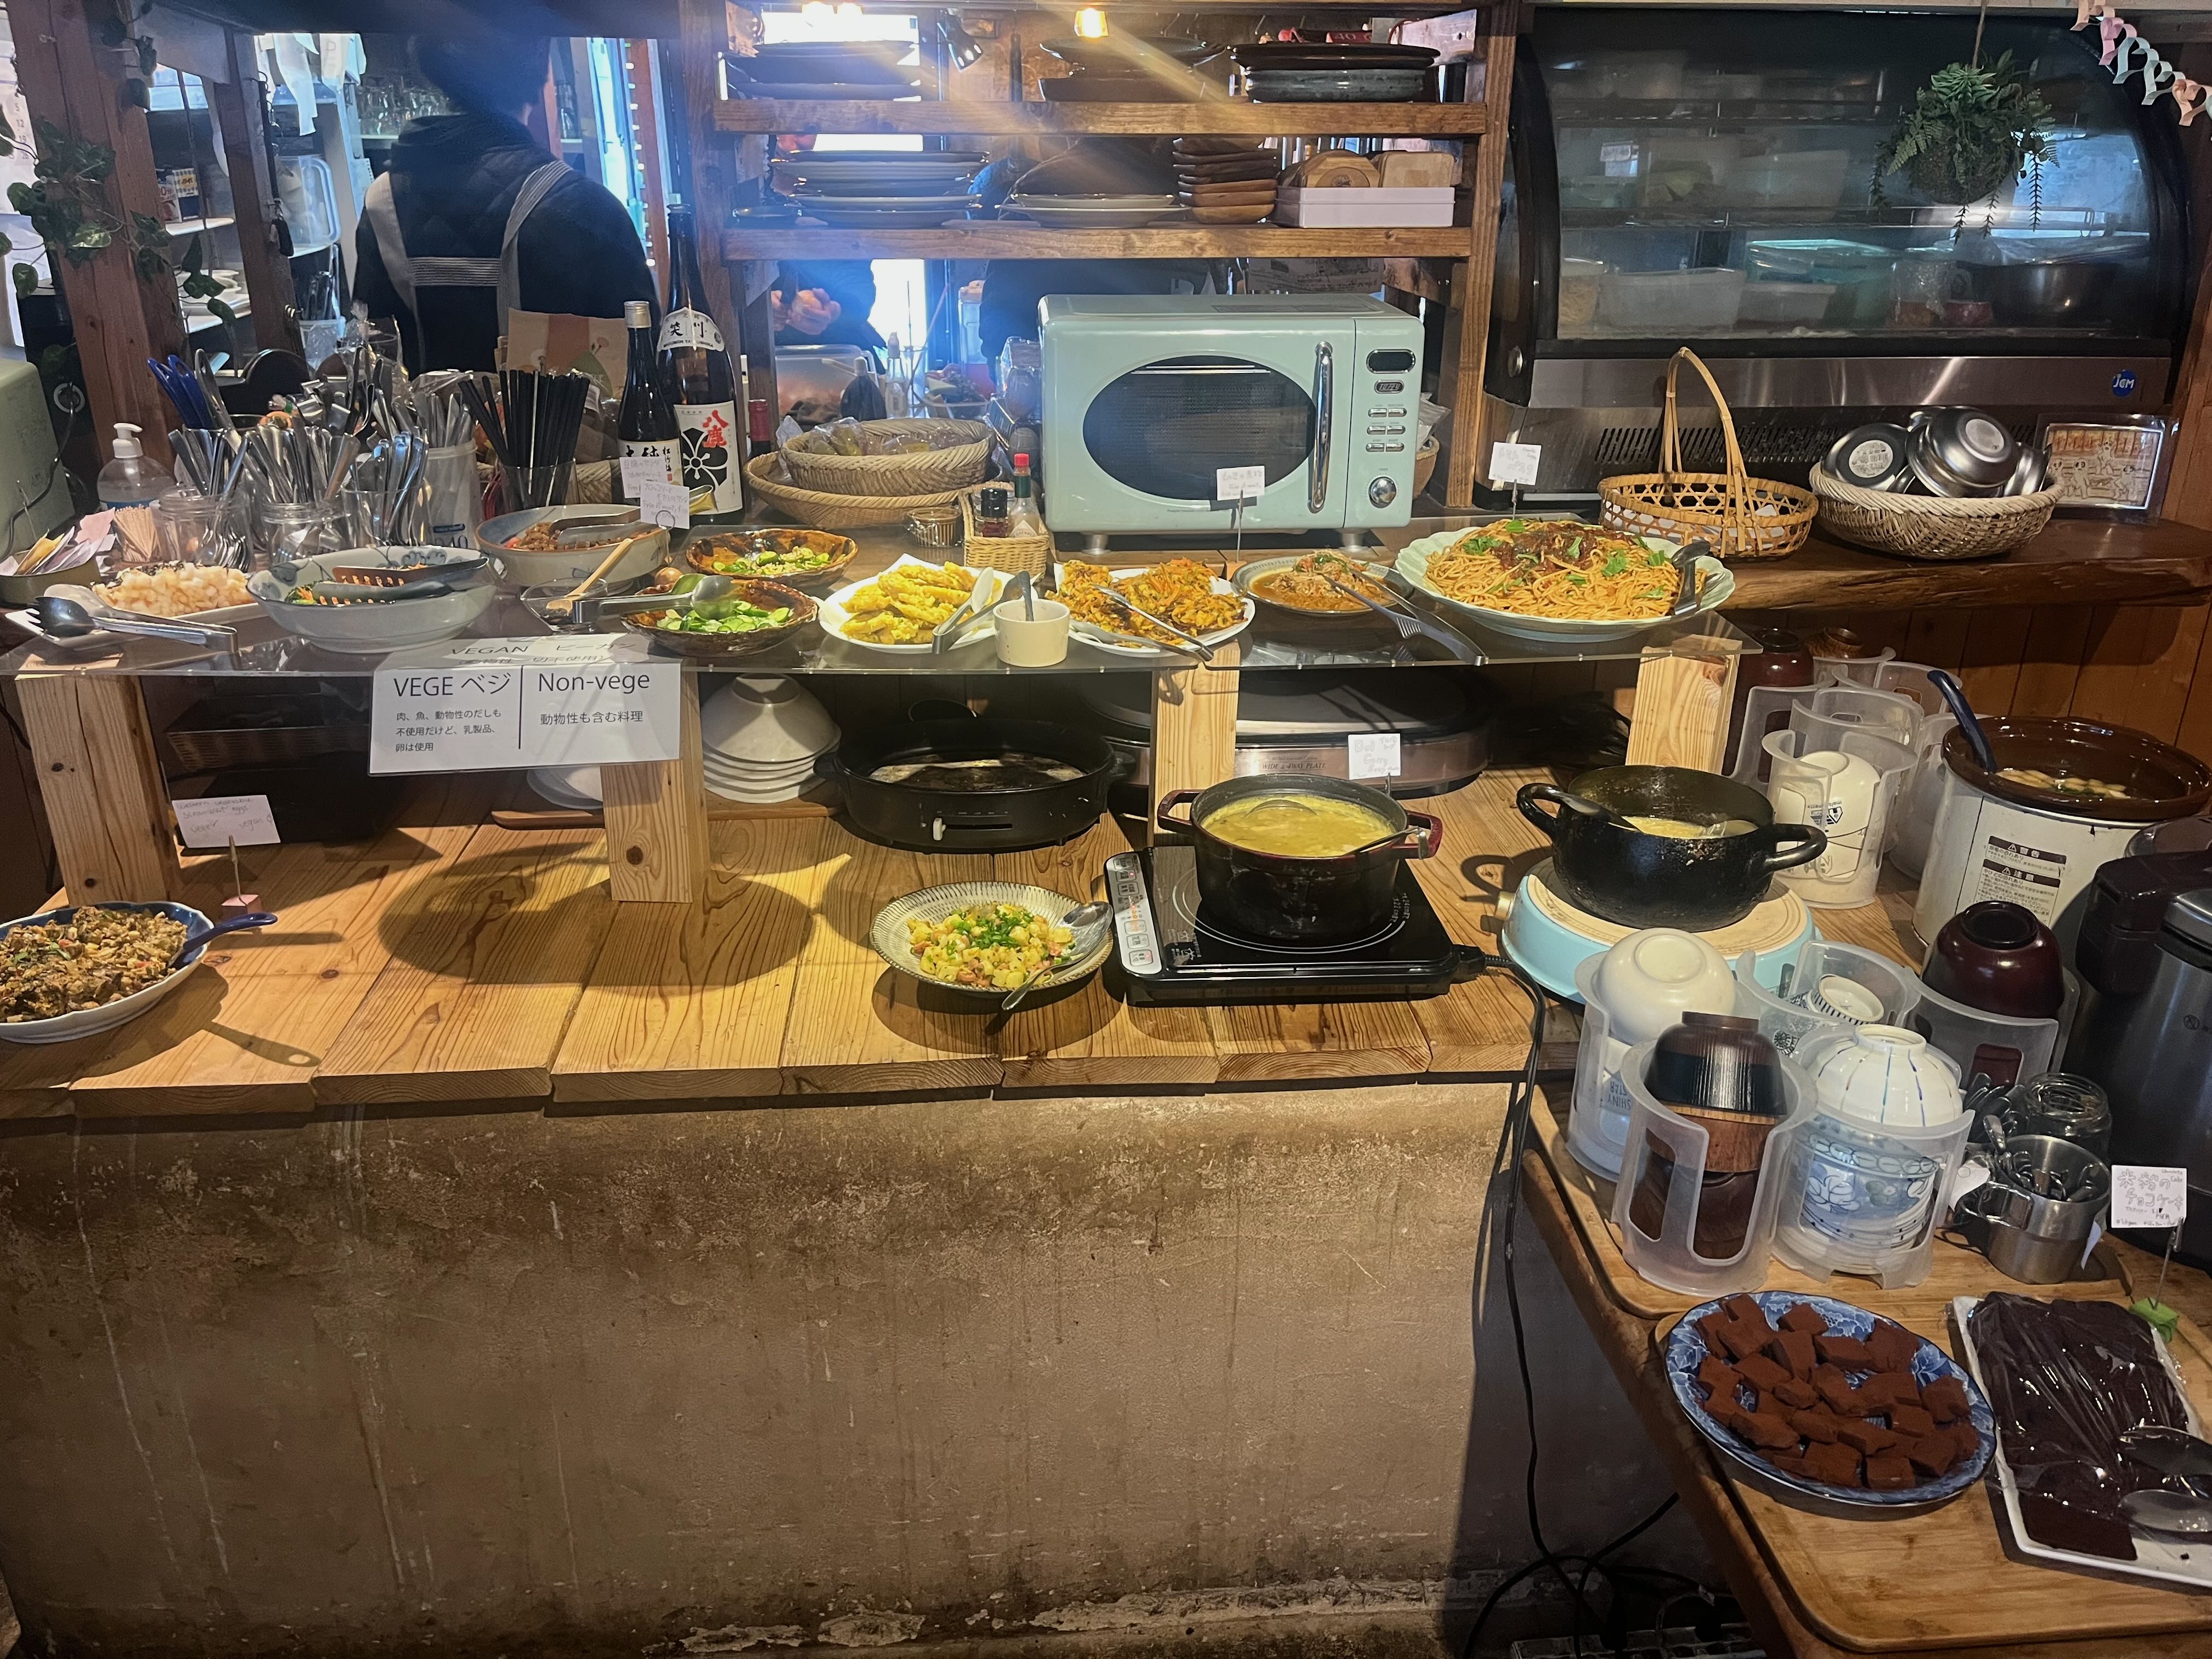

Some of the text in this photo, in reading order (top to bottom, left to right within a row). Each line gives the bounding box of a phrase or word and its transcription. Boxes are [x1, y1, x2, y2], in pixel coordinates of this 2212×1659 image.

[703, 410, 729, 448] 八鹿
[452, 645, 529, 655] VEGAN
[393, 672, 512, 697] VEGE ベジ
[538, 673, 651, 695] Non-vege
[396, 708, 501, 721] 肉、魚、動物性のだしも
[539, 710, 644, 726] 動物性も含む料理
[396, 724, 495, 737] 不使用だけど、乳製品、
[395, 742, 434, 753] 卵は使用
[1610, 1081, 1628, 1096] STAR
[1607, 1094, 1632, 1111] SHINY
